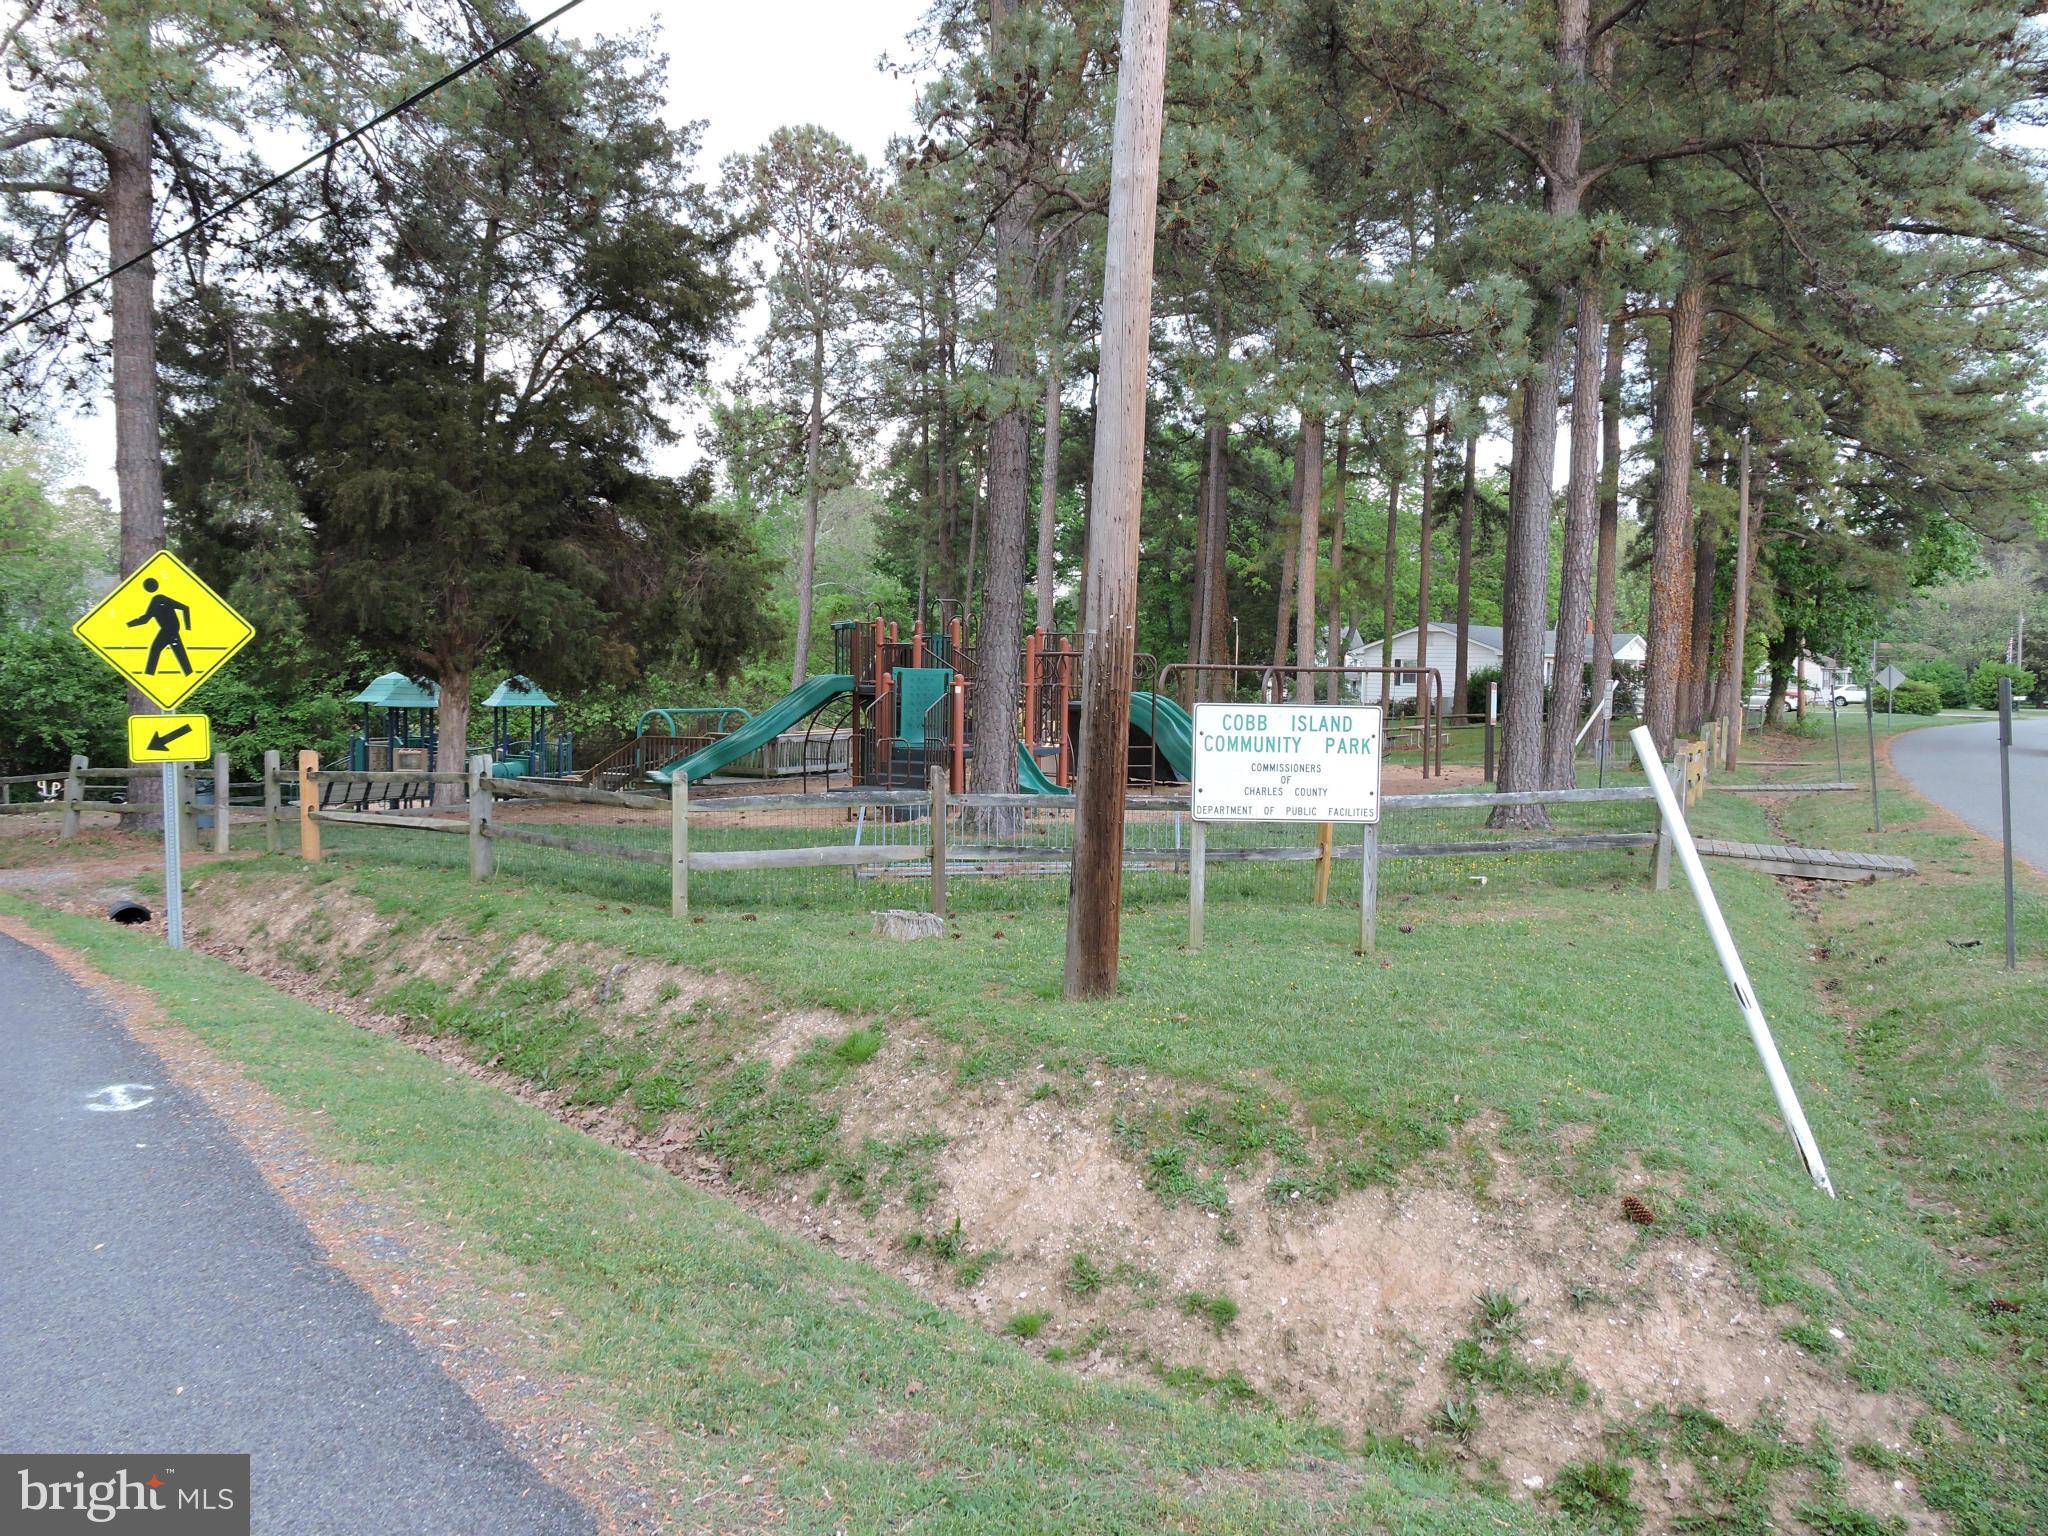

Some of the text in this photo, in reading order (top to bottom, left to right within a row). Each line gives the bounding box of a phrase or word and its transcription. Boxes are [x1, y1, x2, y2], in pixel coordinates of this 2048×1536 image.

[1222, 714, 1353, 732] COBB ISLAND
[1204, 735, 1371, 754] COMMUNITY PARK
[1251, 763, 1322, 773] COMMISSIONERS
[1280, 776, 1292, 784] OF
[1244, 787, 1328, 796] CHARLES COUNTY
[1196, 805, 1374, 817] DEPARTMENT OF PUBLIC FACILITIES
